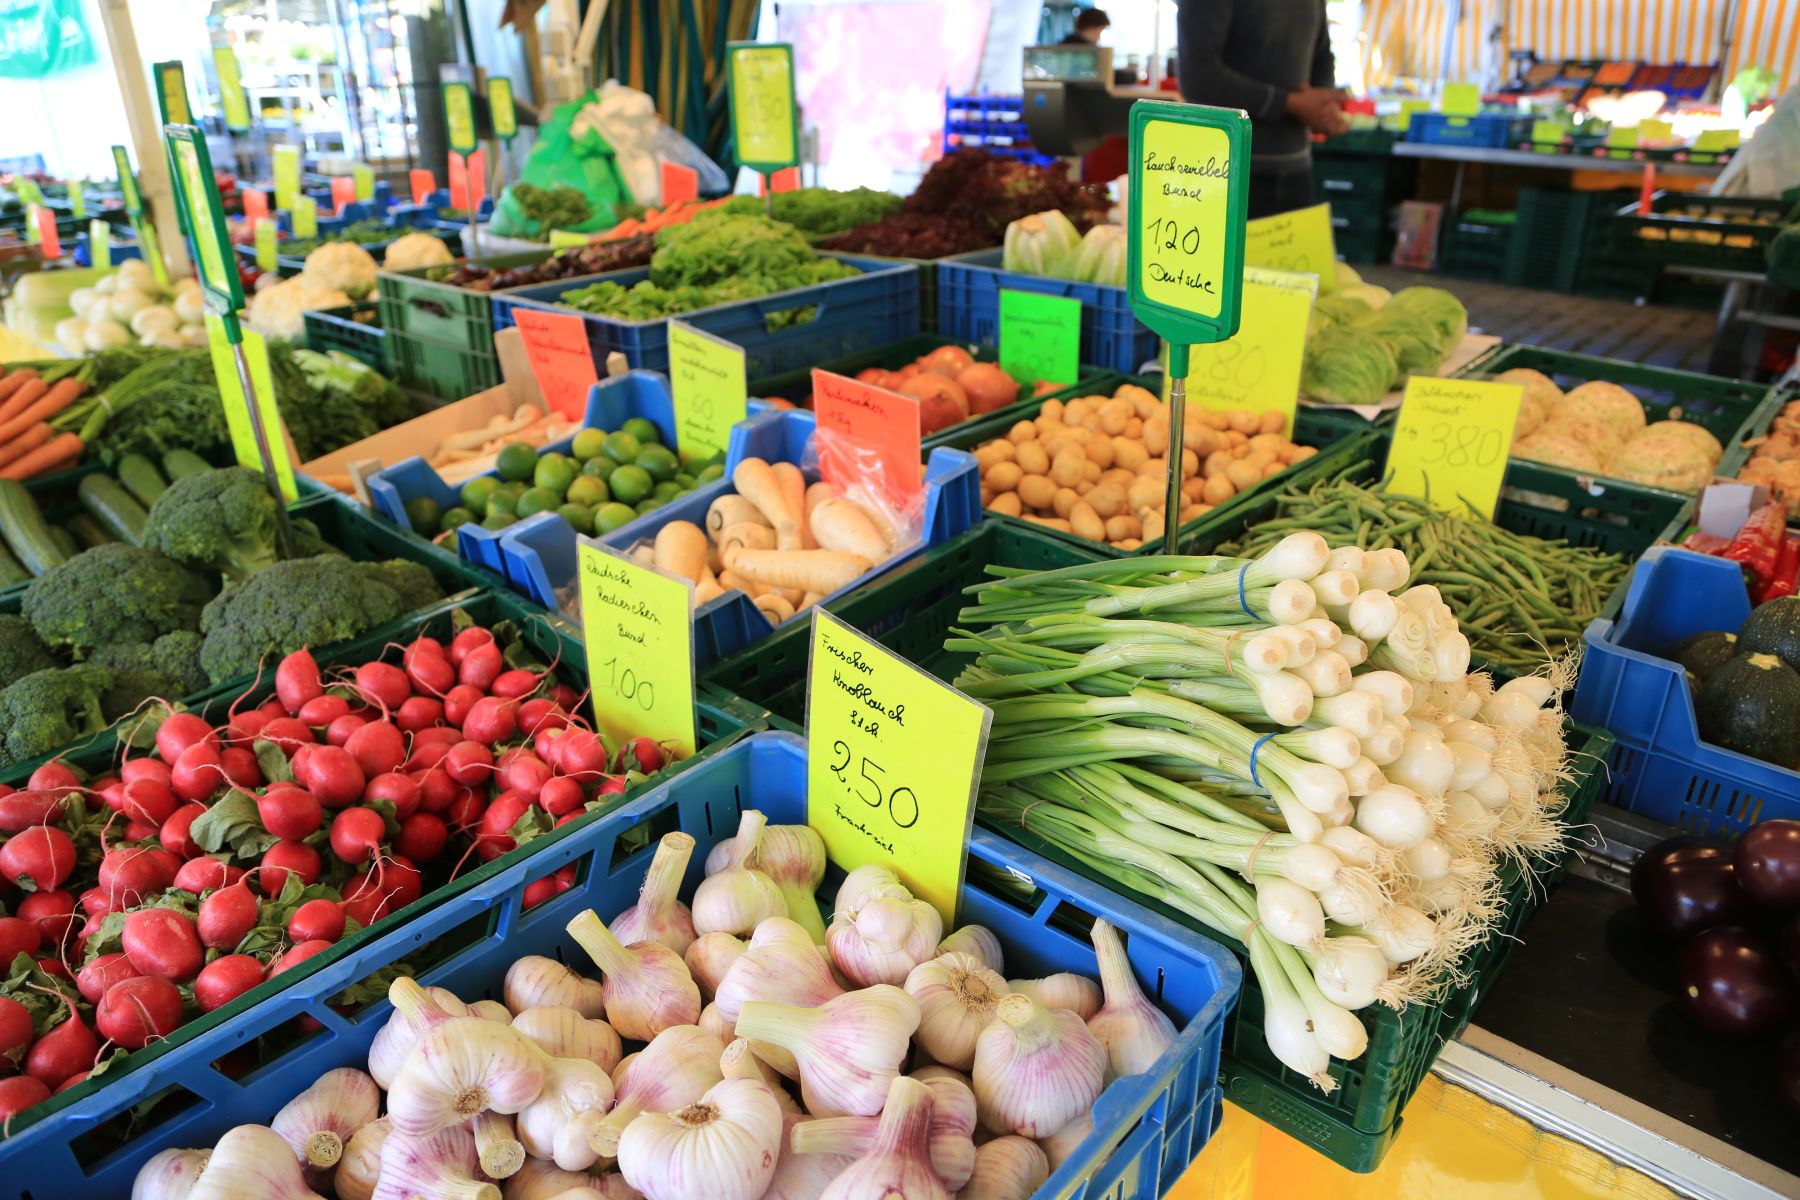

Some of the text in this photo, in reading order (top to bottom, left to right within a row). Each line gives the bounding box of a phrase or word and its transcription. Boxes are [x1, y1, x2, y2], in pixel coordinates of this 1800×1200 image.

[1163, 183, 1202, 202] Bund
[1147, 217, 1200, 255] 1,20
[1148, 263, 1216, 295] Deutsche
[586, 555, 632, 588] Deutsche
[597, 585, 661, 625] Radieschen
[617, 623, 646, 647] Bund
[822, 633, 874, 676] Frischer
[604, 658, 654, 711] 1,00
[833, 669, 905, 727] Knoblauch
[830, 740, 919, 829] 2,50
[835, 803, 894, 855] Frankreich
